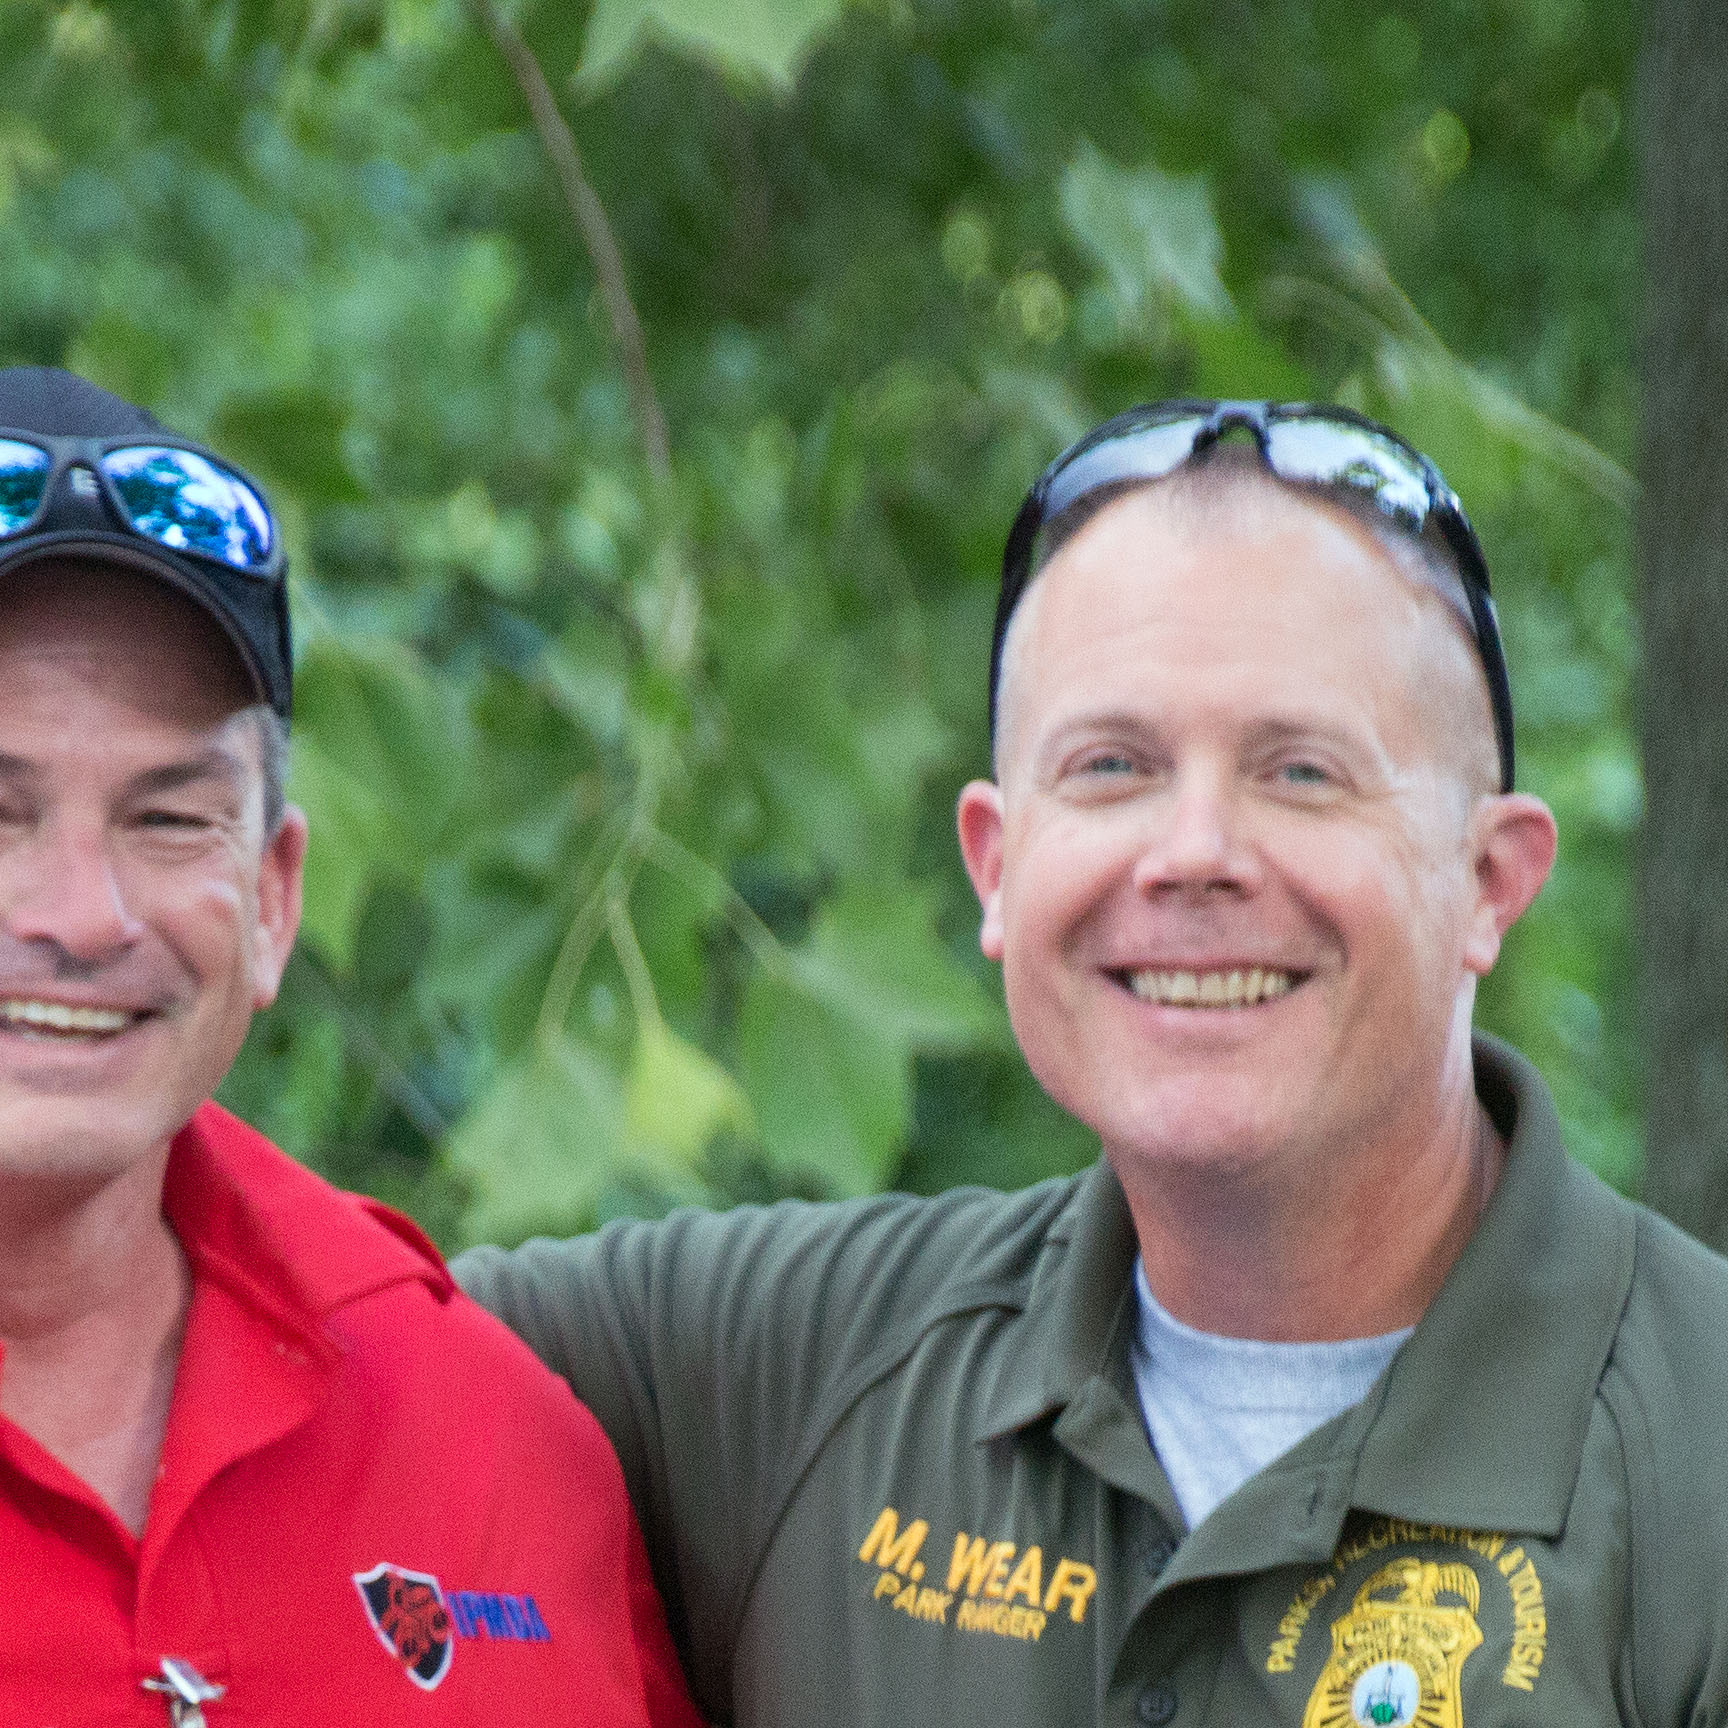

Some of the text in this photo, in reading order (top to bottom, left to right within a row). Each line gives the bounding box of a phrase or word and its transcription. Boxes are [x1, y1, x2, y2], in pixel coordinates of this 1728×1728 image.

[857, 1506, 1098, 1624] M. WEAR
[873, 1571, 1048, 1642] PARK RANGER
[1502, 1557, 1548, 1693] TOURISM
